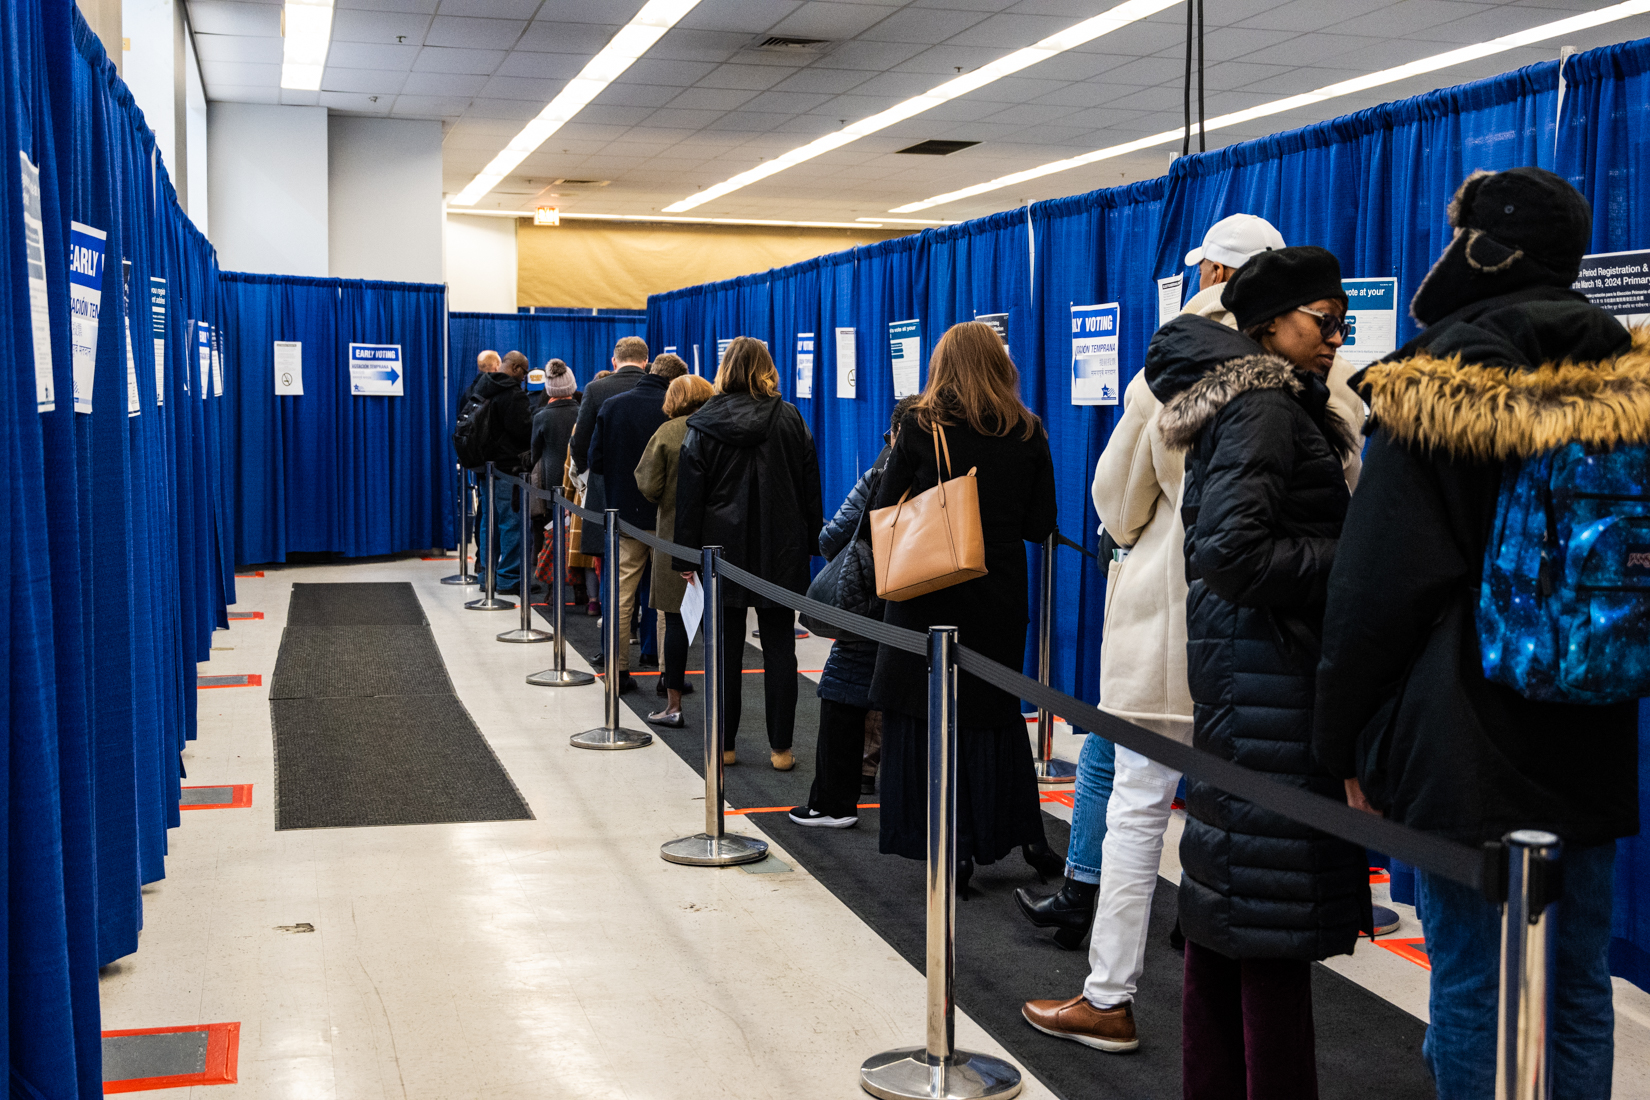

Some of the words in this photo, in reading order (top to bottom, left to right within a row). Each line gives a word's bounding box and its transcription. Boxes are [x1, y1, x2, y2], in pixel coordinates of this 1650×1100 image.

[1583, 268, 1597, 277] Period
[1598, 265, 1640, 277] Registration
[1642, 263, 1649, 272] &
[1581, 279, 1594, 288] March
[1595, 280, 1604, 288] 19,
[1605, 278, 1621, 286] 2024
[1345, 288, 1358, 296] vote
[1360, 288, 1367, 296] at
[1368, 288, 1385, 297] your
[71, 297, 89, 317] ACIÓN
[1085, 315, 1113, 332] VOTING
[1091, 343, 1116, 353] TEMPRANA
[356, 349, 375, 358] EARLY
[375, 350, 396, 359] VOTING
